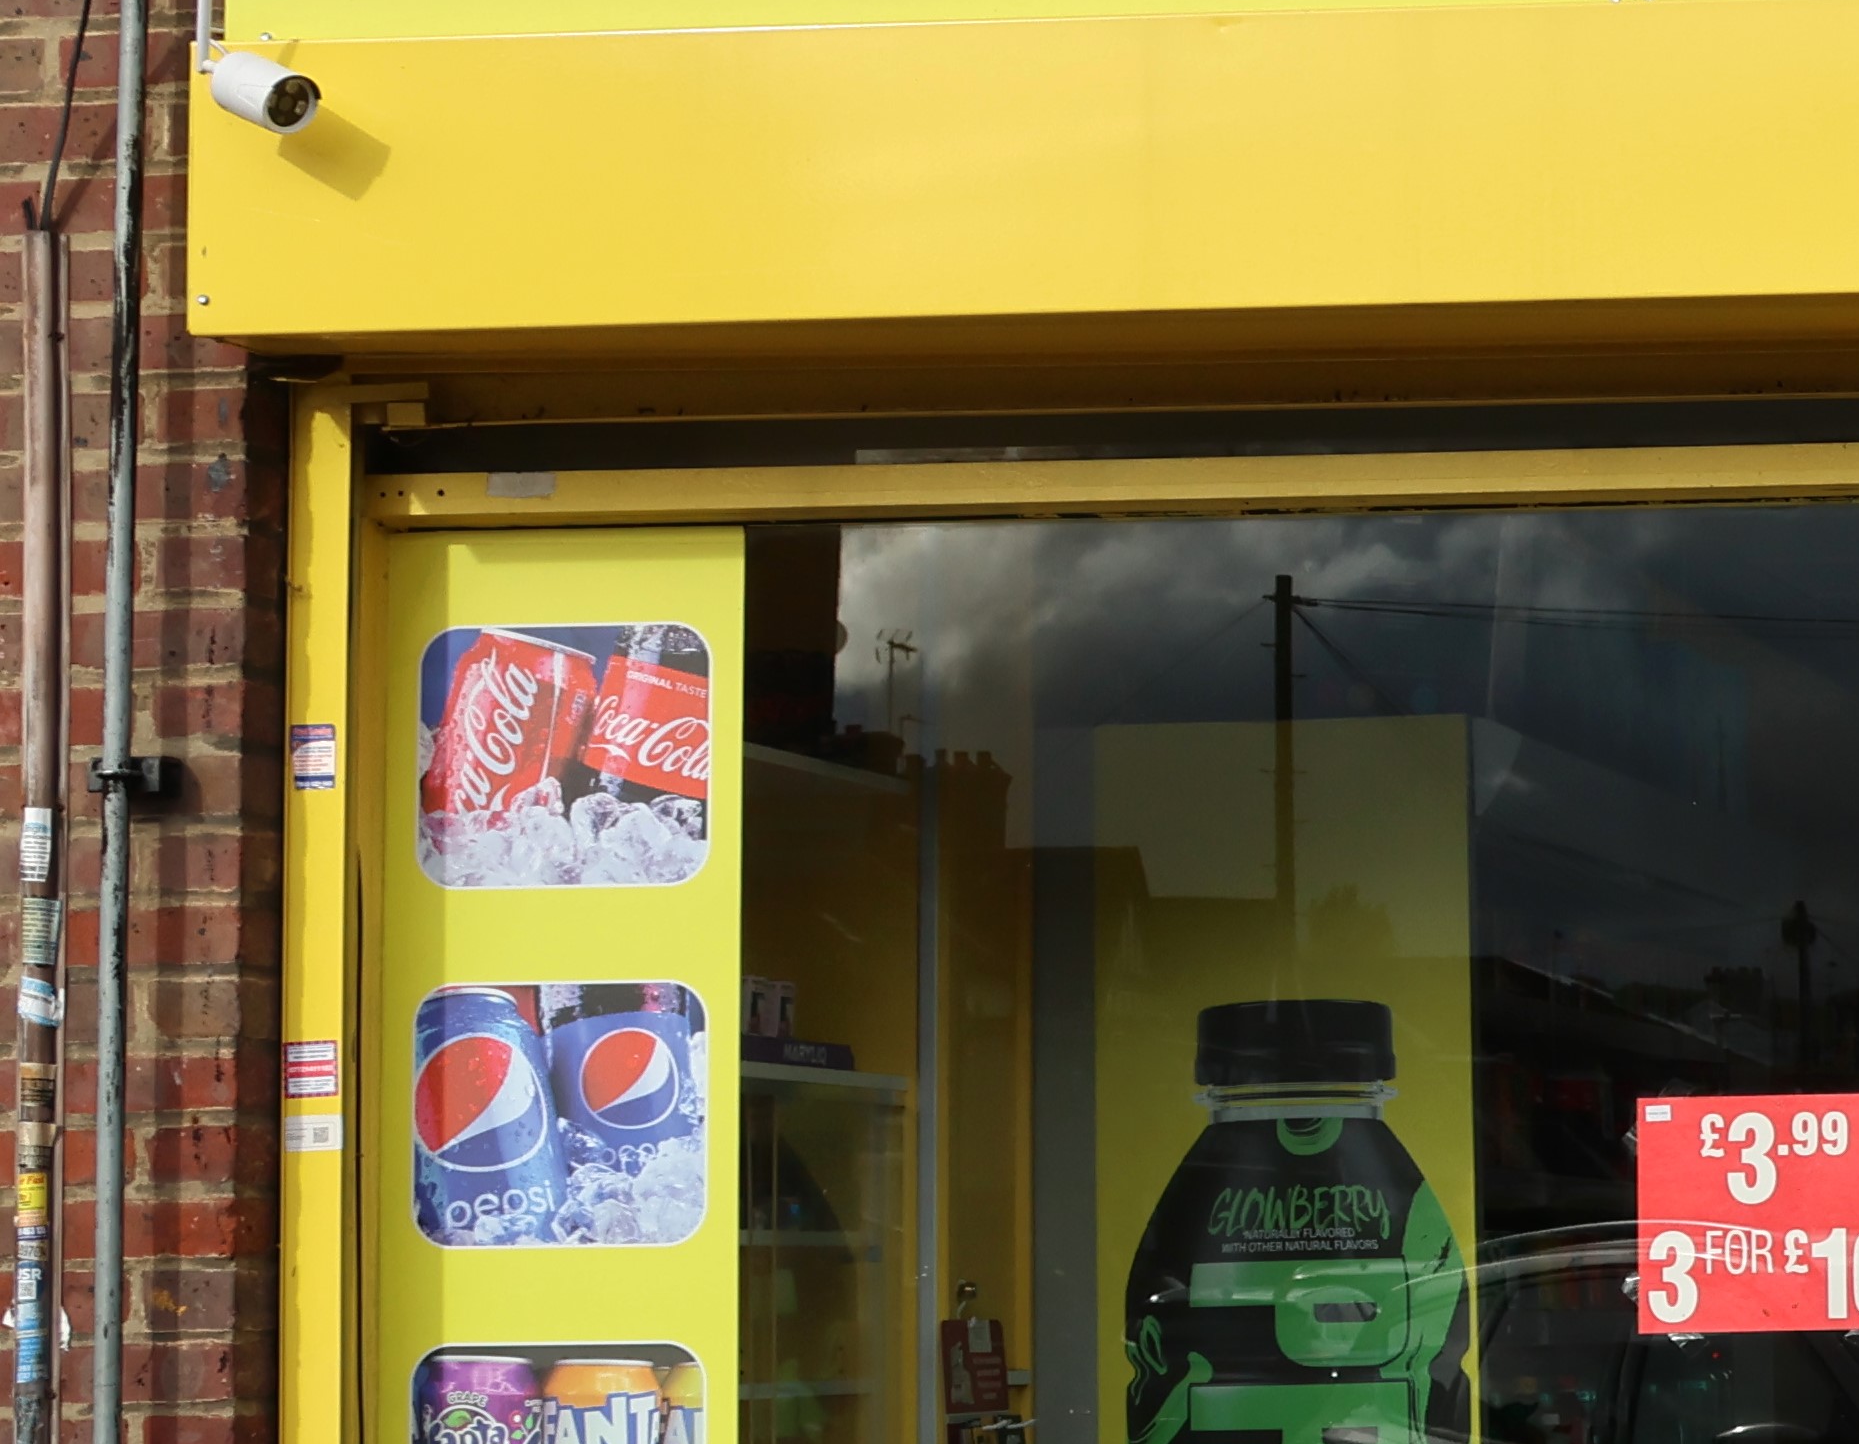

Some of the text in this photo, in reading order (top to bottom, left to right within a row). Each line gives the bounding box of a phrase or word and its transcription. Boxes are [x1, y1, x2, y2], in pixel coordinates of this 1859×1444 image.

[627, 670, 708, 699] ORIGINAL TASTE
[453, 646, 539, 814] ca-Cola
[1700, 1111, 1848, 1205] £3.99
[445, 1180, 556, 1230] pepsi
[1208, 1185, 1391, 1240] GLOWBERRY
[1249, 1241, 1284, 1253] OTHER
[1285, 1240, 1333, 1252] NATURAL
[1334, 1239, 1379, 1251] FLAVORS
[1648, 1230, 1698, 1323] 3
[1705, 1230, 1774, 1275] FOR
[447, 1391, 488, 1407] GRAPE
